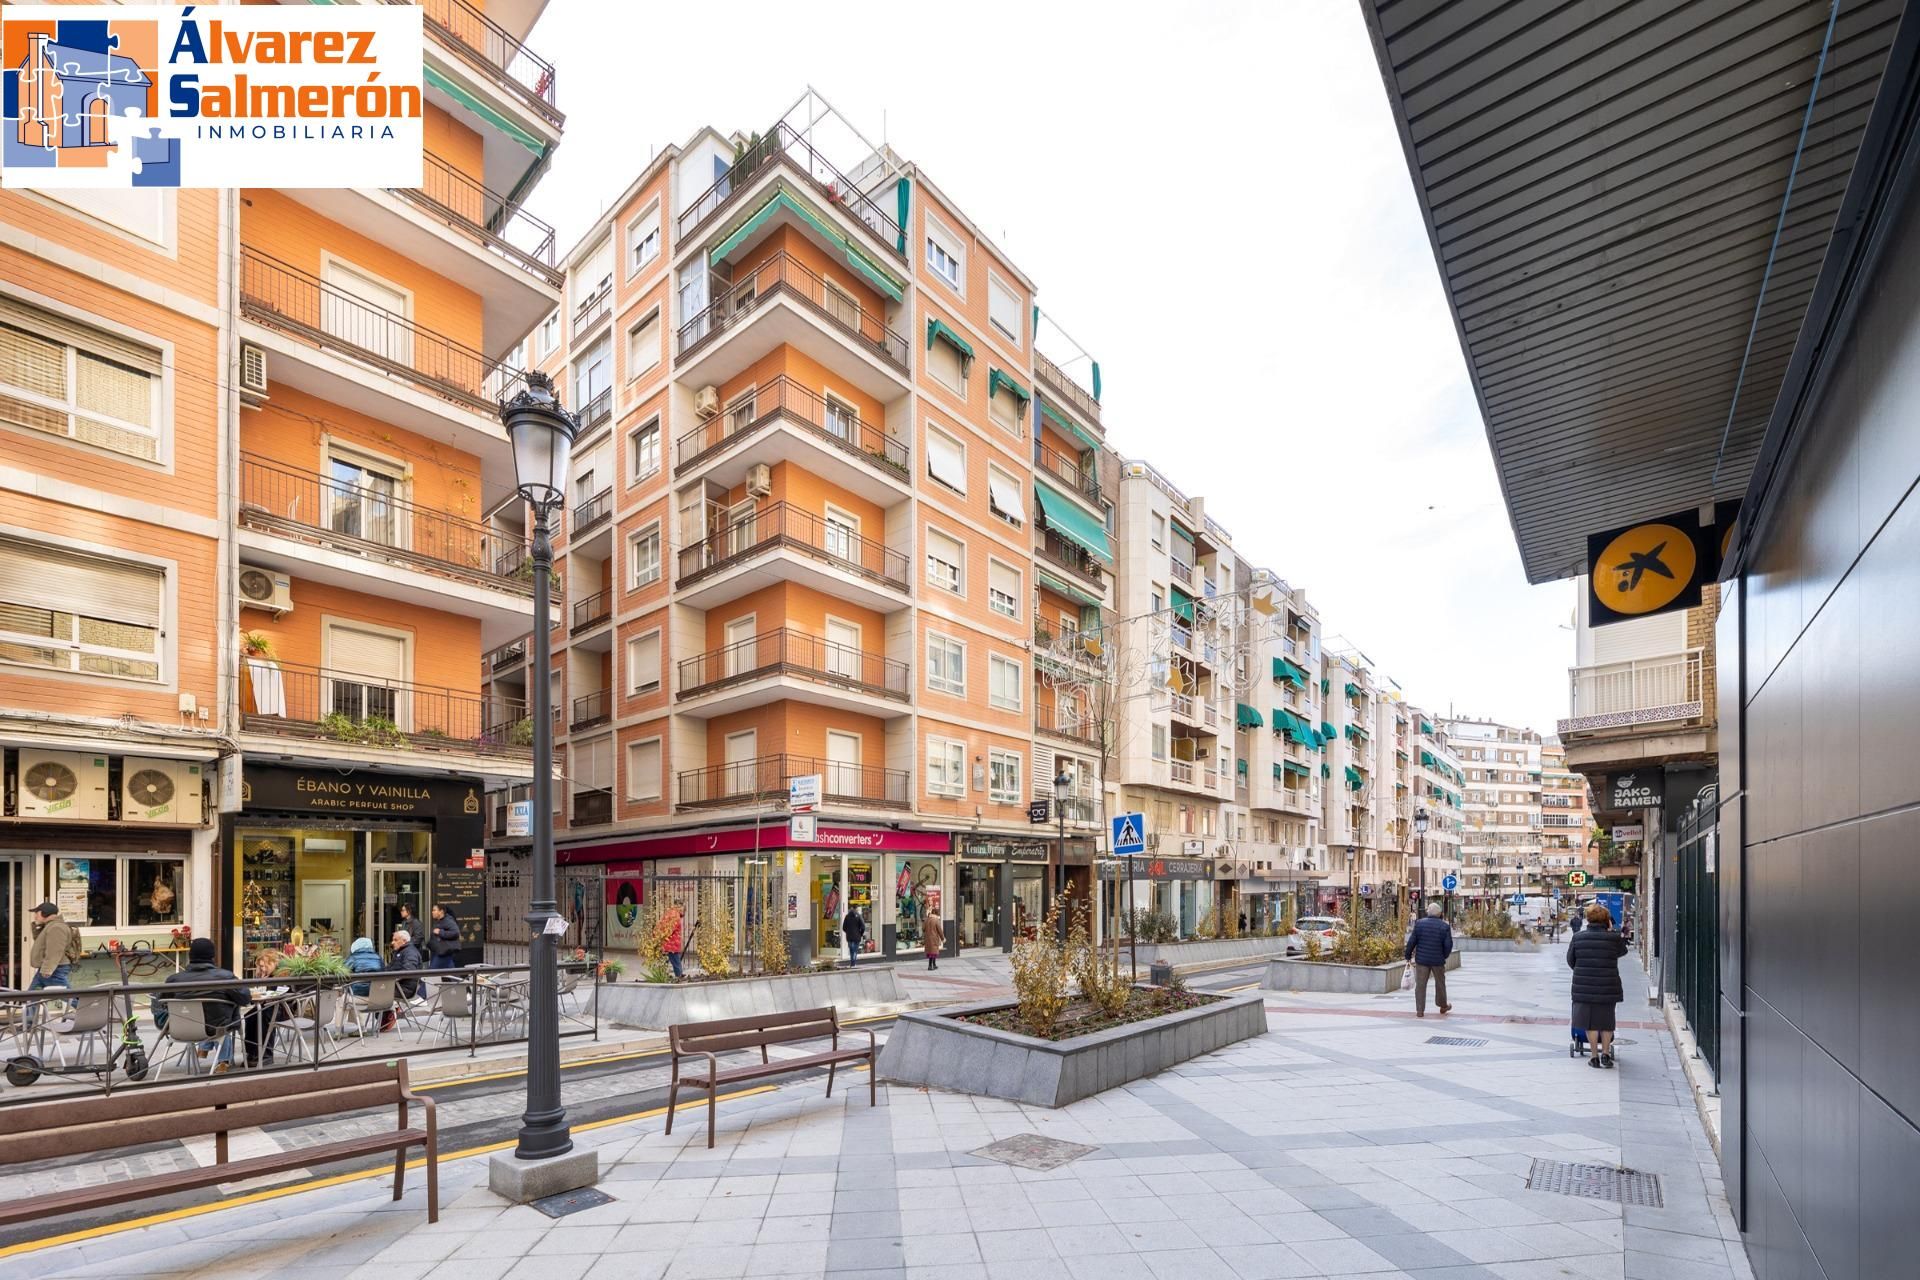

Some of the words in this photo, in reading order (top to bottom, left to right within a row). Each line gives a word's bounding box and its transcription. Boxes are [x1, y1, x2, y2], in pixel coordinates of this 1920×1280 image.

[296, 777, 352, 794] ÉBANO
[355, 784, 365, 794] Y
[369, 785, 431, 799] VAINILLA
[1614, 787, 1650, 798] JAKO
[310, 798, 346, 807] ARABIC
[349, 801, 388, 810] PERFUME
[390, 803, 415, 811] SHOP
[1614, 796, 1661, 807] RAMEN
[815, 831, 872, 845] ashconverters
